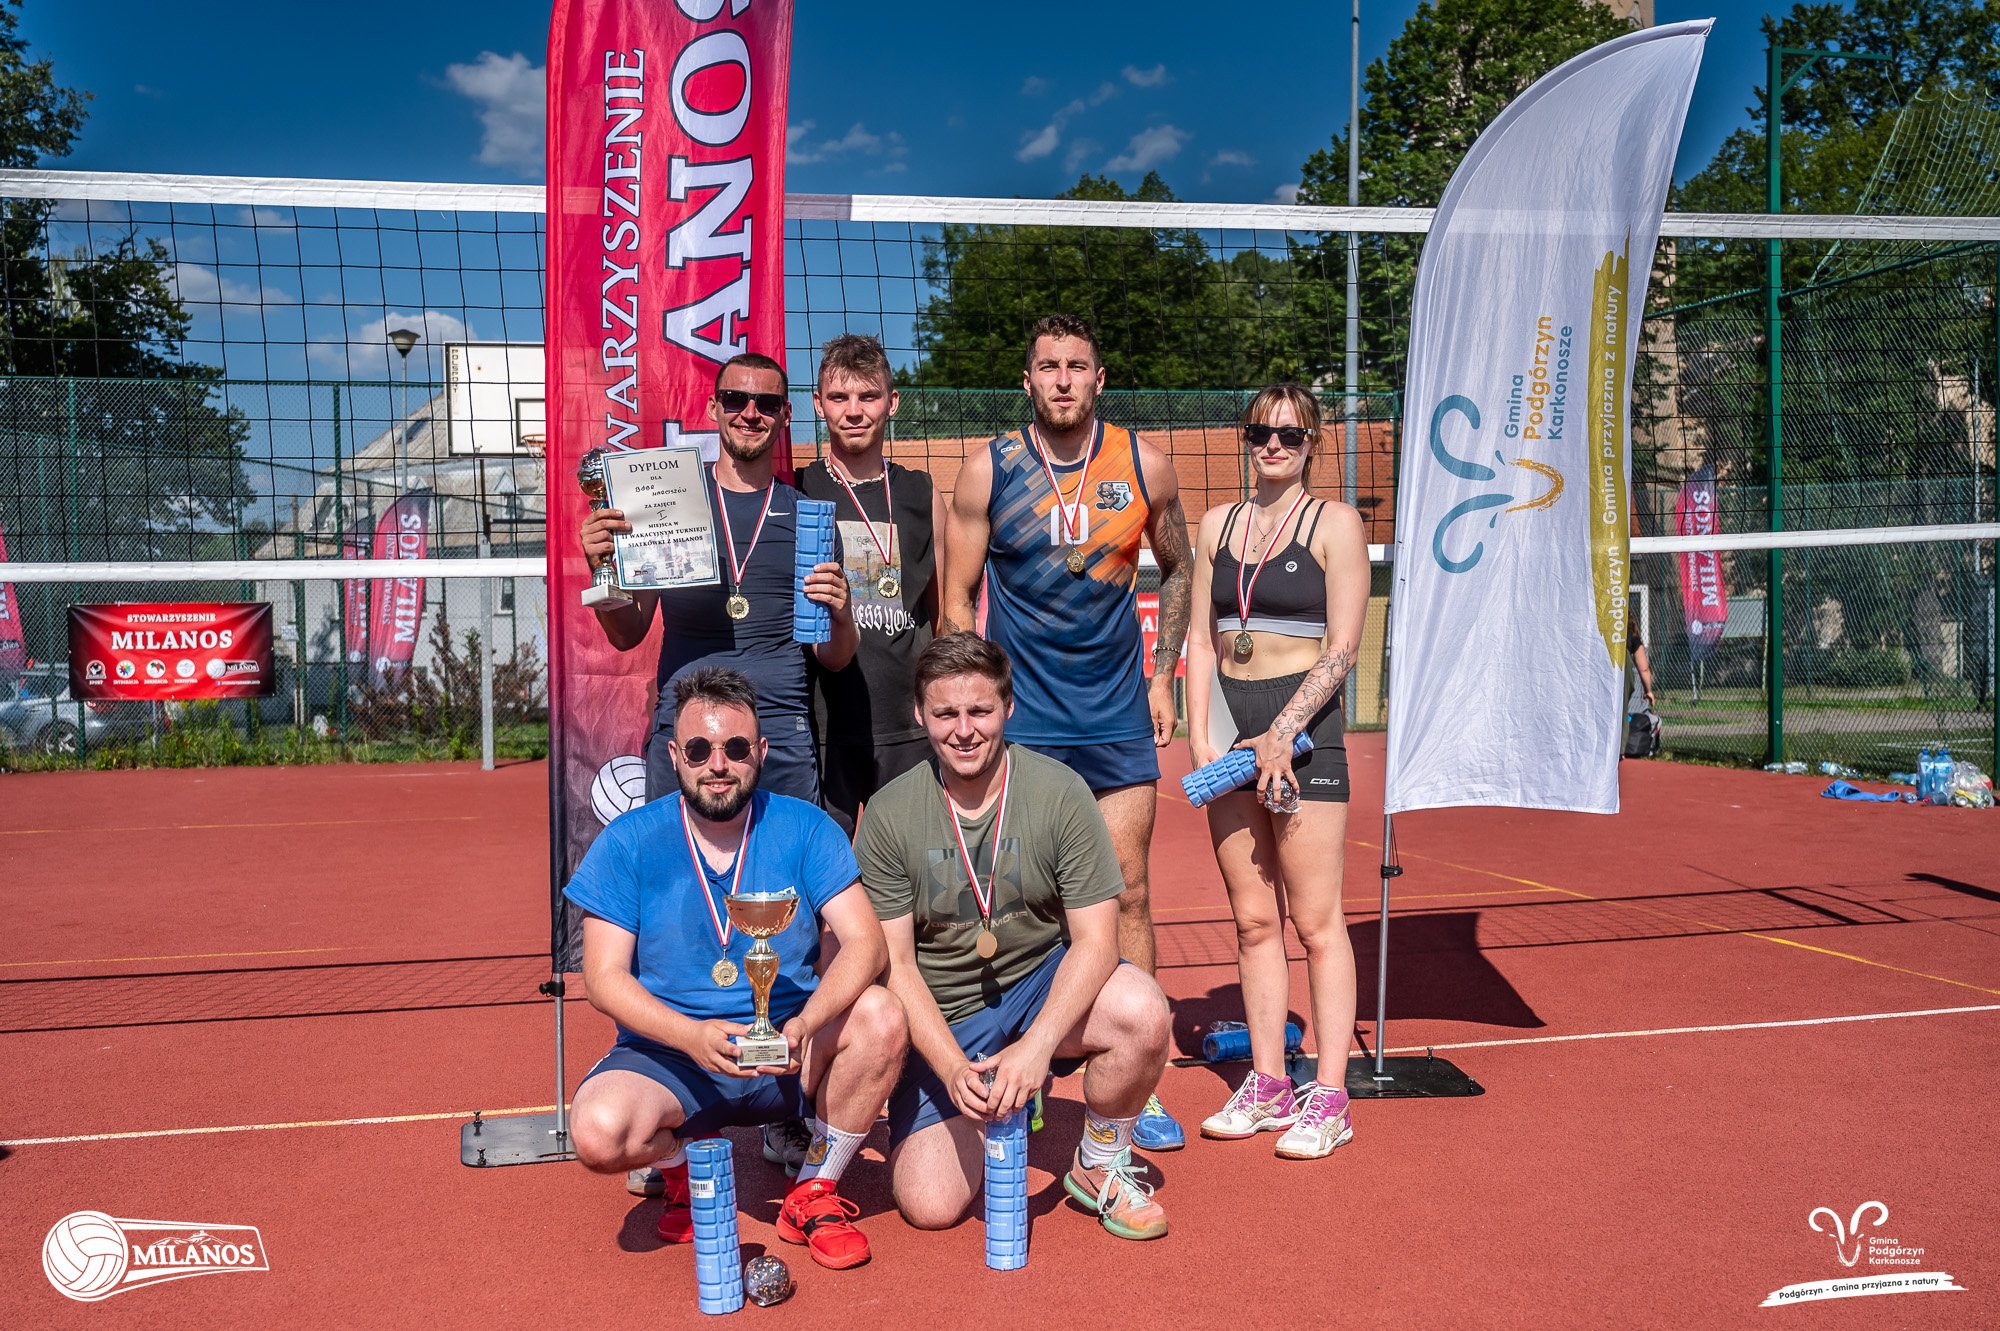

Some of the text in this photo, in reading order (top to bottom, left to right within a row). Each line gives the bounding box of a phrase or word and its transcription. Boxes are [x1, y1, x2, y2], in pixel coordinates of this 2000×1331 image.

[602, 48, 646, 452] WARZYSZENIE
[1604, 285, 1622, 345] natury
[1606, 351, 1616, 361] z
[1523, 316, 1555, 440] Podgórzyn
[1548, 325, 1572, 440] Karkonosze
[1504, 374, 1523, 438] Gmina
[1600, 367, 1616, 458] przyjazna
[629, 460, 680, 473] DYPLOM
[1000, 444, 1022, 453] COLO
[1602, 465, 1617, 525] Gmina
[630, 530, 674, 539] WAKACYJNYM
[675, 526, 708, 535] TURNIEJU
[673, 535, 704, 543] MILANOS
[1607, 546, 1627, 643] Podgórzyn
[127, 613, 216, 623] STOWARZYSZENIE
[111, 629, 233, 650] MILANOS
[1310, 777, 1340, 785] COLO
